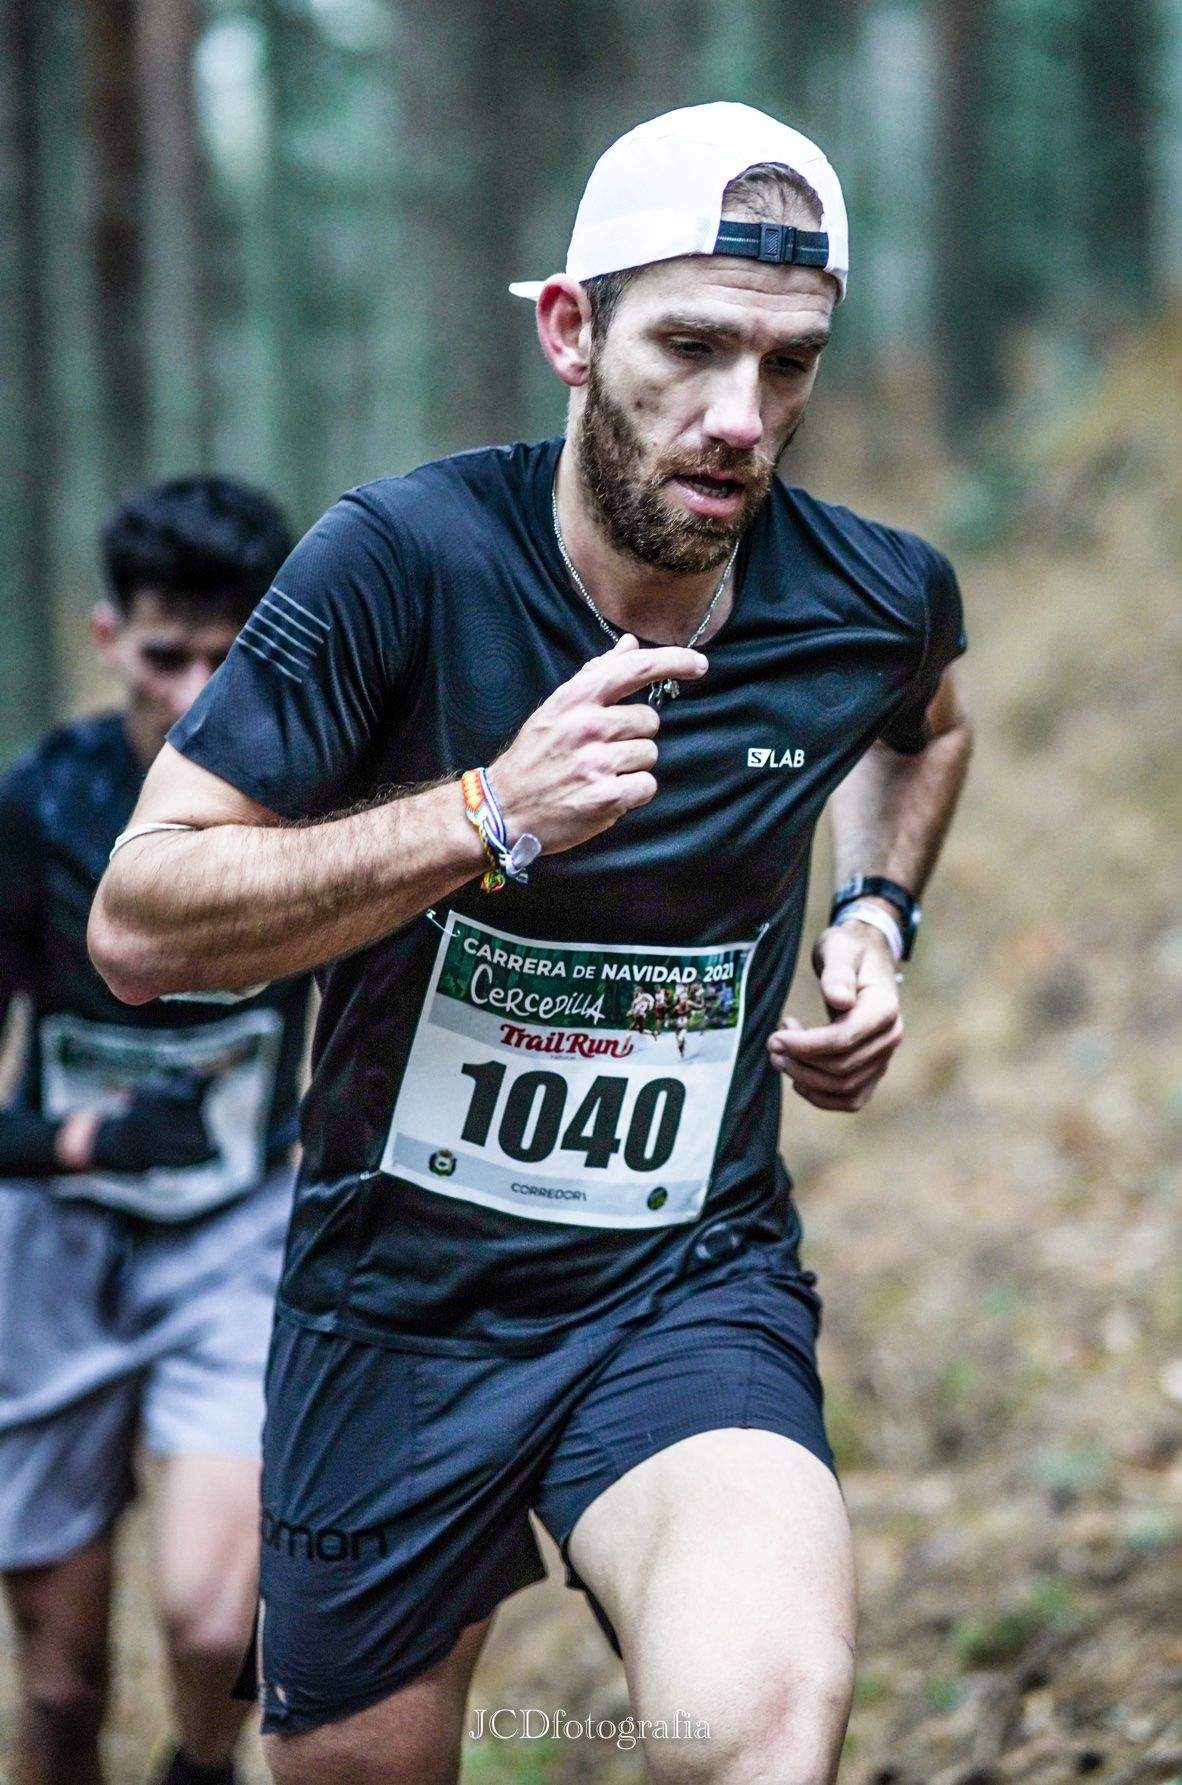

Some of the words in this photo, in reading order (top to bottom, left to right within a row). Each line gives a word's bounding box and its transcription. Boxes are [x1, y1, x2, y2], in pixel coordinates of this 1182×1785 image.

[463, 937, 566, 978] CARRERA
[572, 965, 596, 980] DE
[601, 963, 698, 984] NAVIDAD
[703, 961, 734, 983] 2021
[500, 1023, 565, 1054] Trail
[565, 1032, 635, 1059] Run
[461, 1060, 687, 1173] 1040
